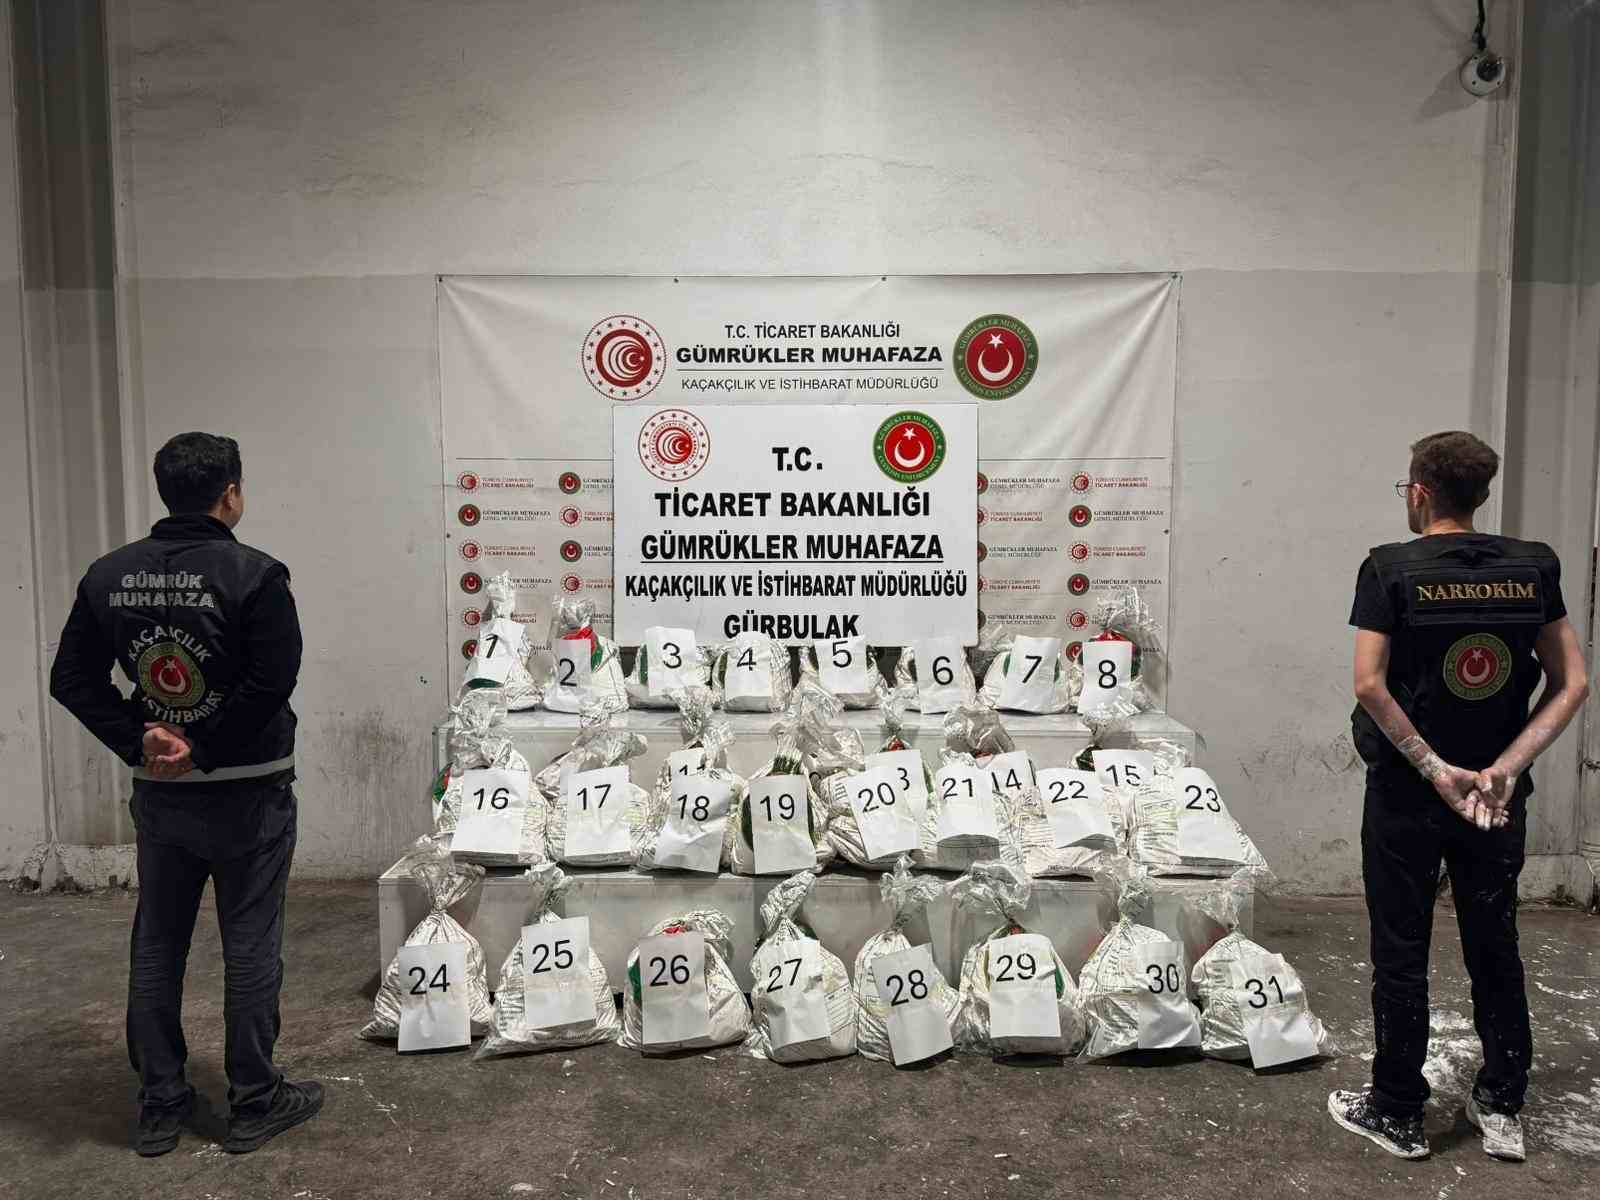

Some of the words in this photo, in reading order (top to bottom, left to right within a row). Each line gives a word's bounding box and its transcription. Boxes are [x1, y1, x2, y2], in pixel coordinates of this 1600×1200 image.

[725, 324, 749, 338] T.C.
[755, 322, 816, 338] TİCARET
[821, 322, 900, 338] BAKANLIĞI
[676, 345, 814, 364] GÜMRÜKLER
[822, 346, 942, 363] MUHAFAZA
[681, 379, 756, 393] KAÇAKÇILIK
[760, 379, 776, 390] VE
[780, 377, 851, 390] İSTİHBARAT
[856, 376, 939, 390] MÜDÜRLÜĞÜ
[771, 446, 823, 472] T.C.
[654, 486, 772, 517] TİCARET
[780, 486, 930, 517] BAKANLIĞI
[641, 530, 798, 560] GÜMRÜKLER
[806, 534, 944, 560] MUHAFAZA
[121, 571, 203, 589] GÜMRÜK
[625, 575, 726, 602] KAÇAKÇILIK
[731, 575, 753, 597] VE
[757, 570, 856, 597] İSTİHBARAT
[861, 570, 967, 597] MÜDÜRLÜĞÜ
[1415, 579, 1537, 601] NARKOKİM
[724, 610, 859, 640] GÜRBULAK
[662, 642, 682, 669] 3
[736, 647, 757, 671] 4
[832, 640, 854, 669] 5
[559, 658, 577, 687] 2
[932, 655, 954, 686] 6
[1022, 655, 1043, 684] 7
[1098, 659, 1118, 689] 8
[942, 777, 974, 800] 21
[991, 768, 1023, 793] 14
[1105, 764, 1141, 787] 15
[473, 787, 510, 811] 16
[577, 783, 612, 811] 17
[857, 782, 896, 813] 20
[1048, 780, 1089, 804] 22
[1185, 784, 1221, 813] 23
[677, 794, 710, 822] 18
[759, 793, 795, 822] 19
[532, 939, 574, 974] 25
[649, 954, 690, 987] 26
[995, 953, 1037, 983] 29
[408, 963, 451, 996] 24
[766, 958, 803, 994] 27
[886, 969, 928, 1007] 28
[1145, 963, 1180, 994] 30
[1244, 975, 1285, 1009] 31
